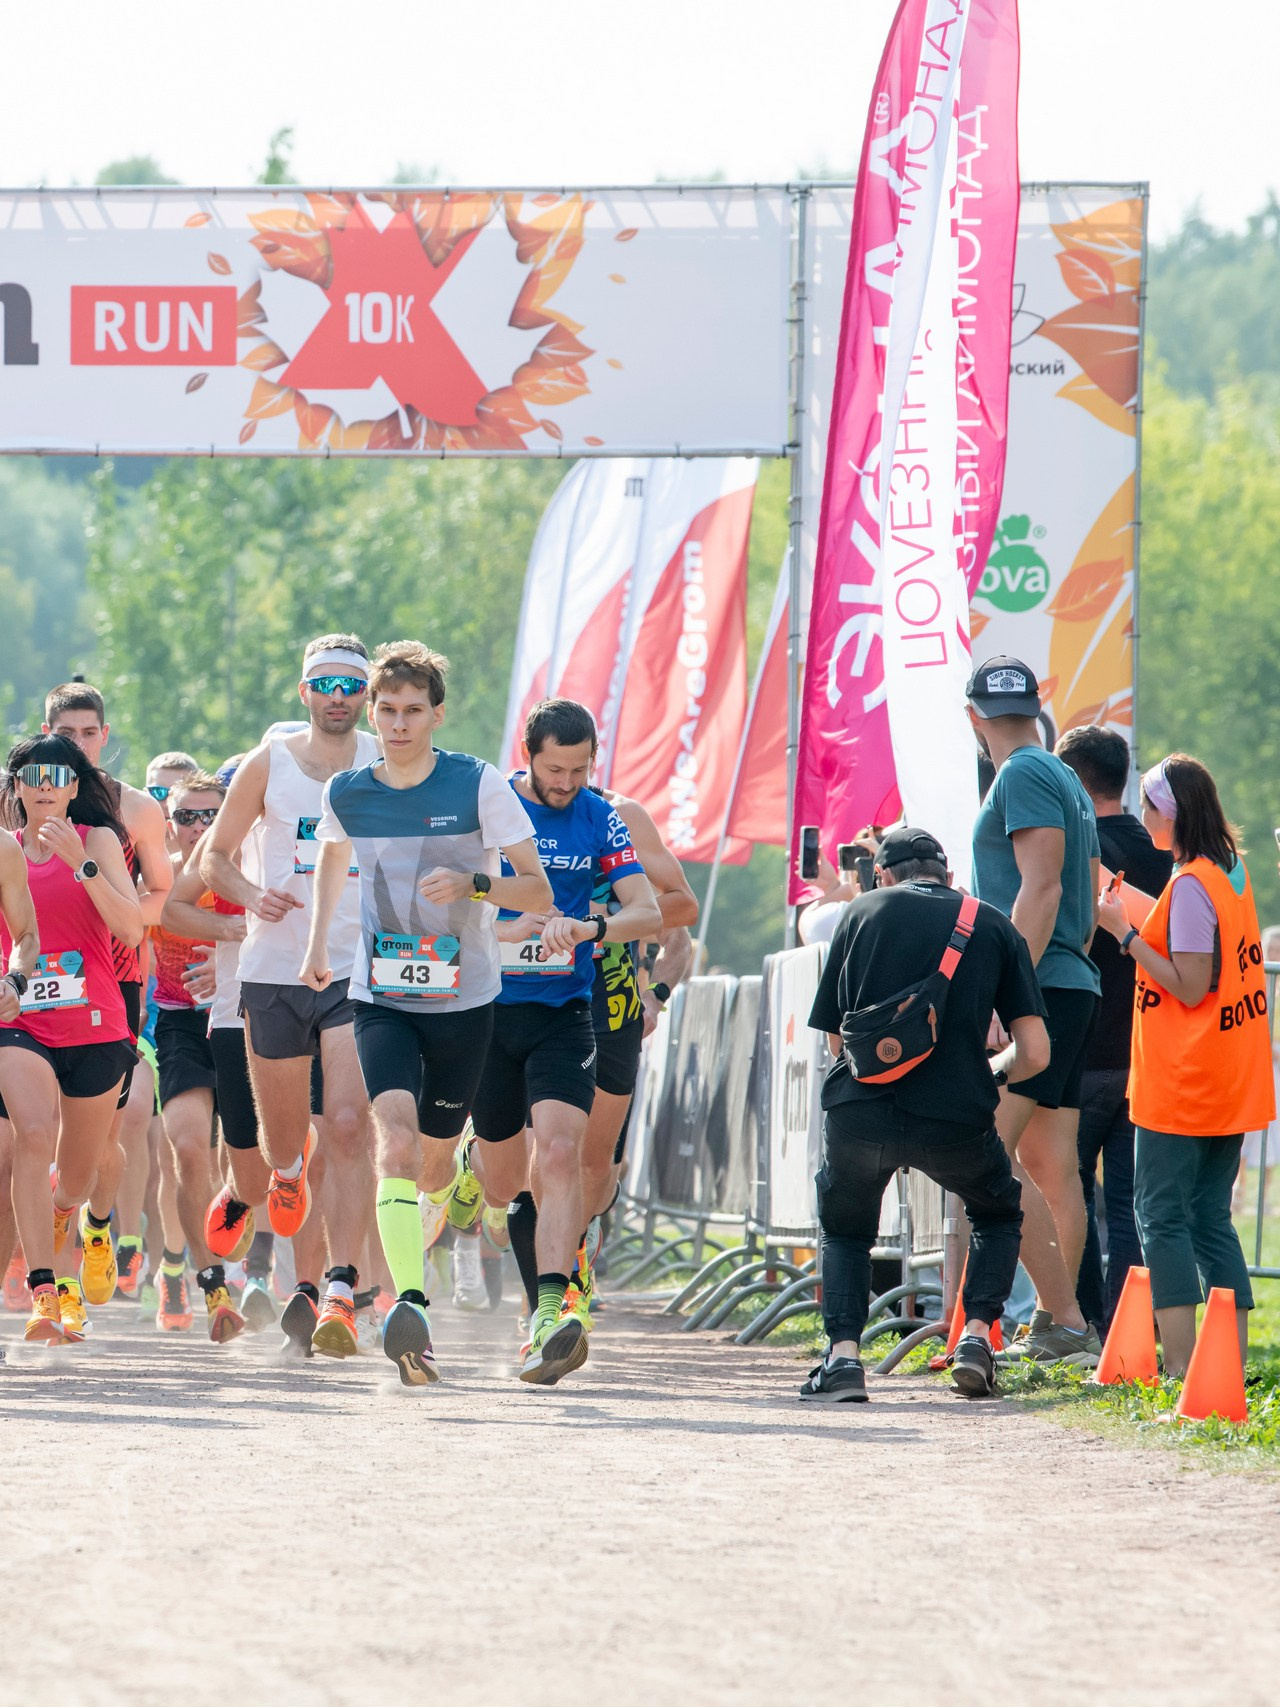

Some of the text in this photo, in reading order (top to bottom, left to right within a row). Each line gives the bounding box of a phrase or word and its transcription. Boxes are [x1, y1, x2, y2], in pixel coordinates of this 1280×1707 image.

[94, 301, 213, 352] RUN
[345, 292, 415, 343] 10K
[978, 565, 1047, 593] ova
[1005, 670, 1024, 682] HOCKEY
[666, 539, 710, 850] #WeAreGrom
[382, 940, 413, 951] grom
[400, 964, 430, 984] 43
[34, 981, 60, 1000] 22
